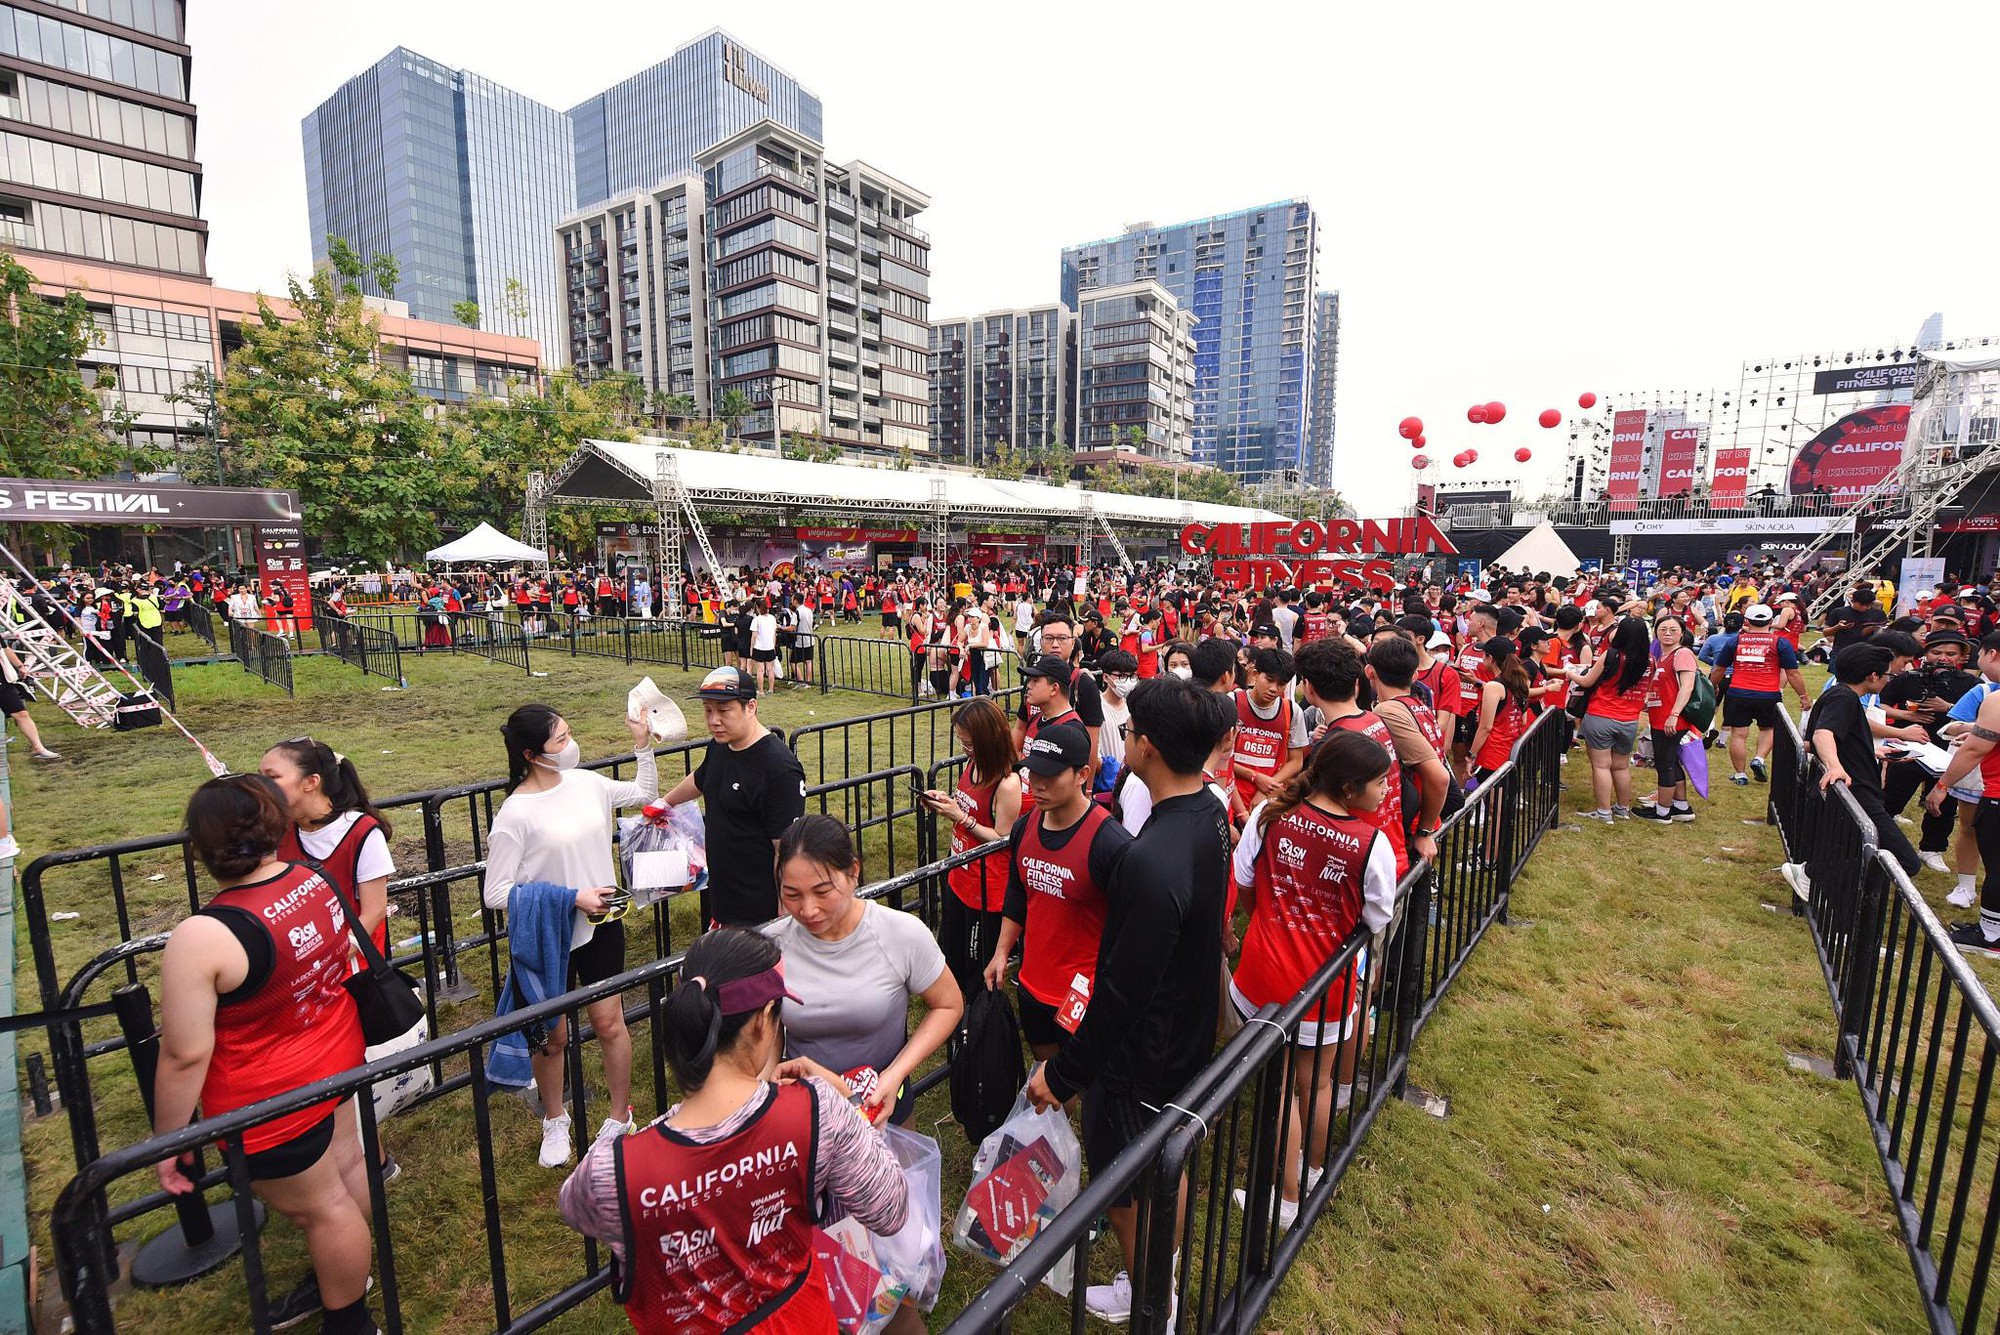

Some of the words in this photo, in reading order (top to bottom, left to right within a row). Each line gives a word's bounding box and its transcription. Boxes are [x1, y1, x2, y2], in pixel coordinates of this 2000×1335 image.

[1836, 377, 1888, 389] FITNESS
[1828, 466, 1885, 477] KICKFIT
[24, 490, 170, 513] FESTIVAL
[1180, 517, 1460, 554] CALIFORNIA
[1767, 523, 1795, 531] AQUA
[1214, 560, 1395, 593] FITNESS
[1240, 727, 1283, 740] CALIFORNIA
[1244, 741, 1272, 755] 06519
[1278, 821, 1316, 838] FITNESS
[1281, 812, 1360, 848] CALIFORNIA
[1285, 844, 1307, 860] ASN
[1022, 856, 1075, 881] CALIFORNIA
[1027, 868, 1063, 888] FITNESS
[1319, 866, 1348, 884] Nut
[1027, 878, 1066, 900] FESTIVAL
[271, 897, 307, 925] FITNESS
[299, 921, 318, 943] ASN
[640, 1141, 798, 1208] CALIFORNIA
[642, 1187, 723, 1220] FITNESS
[735, 1179, 743, 1189] &
[754, 1159, 799, 1181] YOGA
[750, 1187, 786, 1208] VINAMILK
[753, 1199, 785, 1222] Super
[746, 1207, 792, 1248] Nut
[678, 1226, 716, 1259] ASN
[666, 1245, 719, 1271] ARICAN
